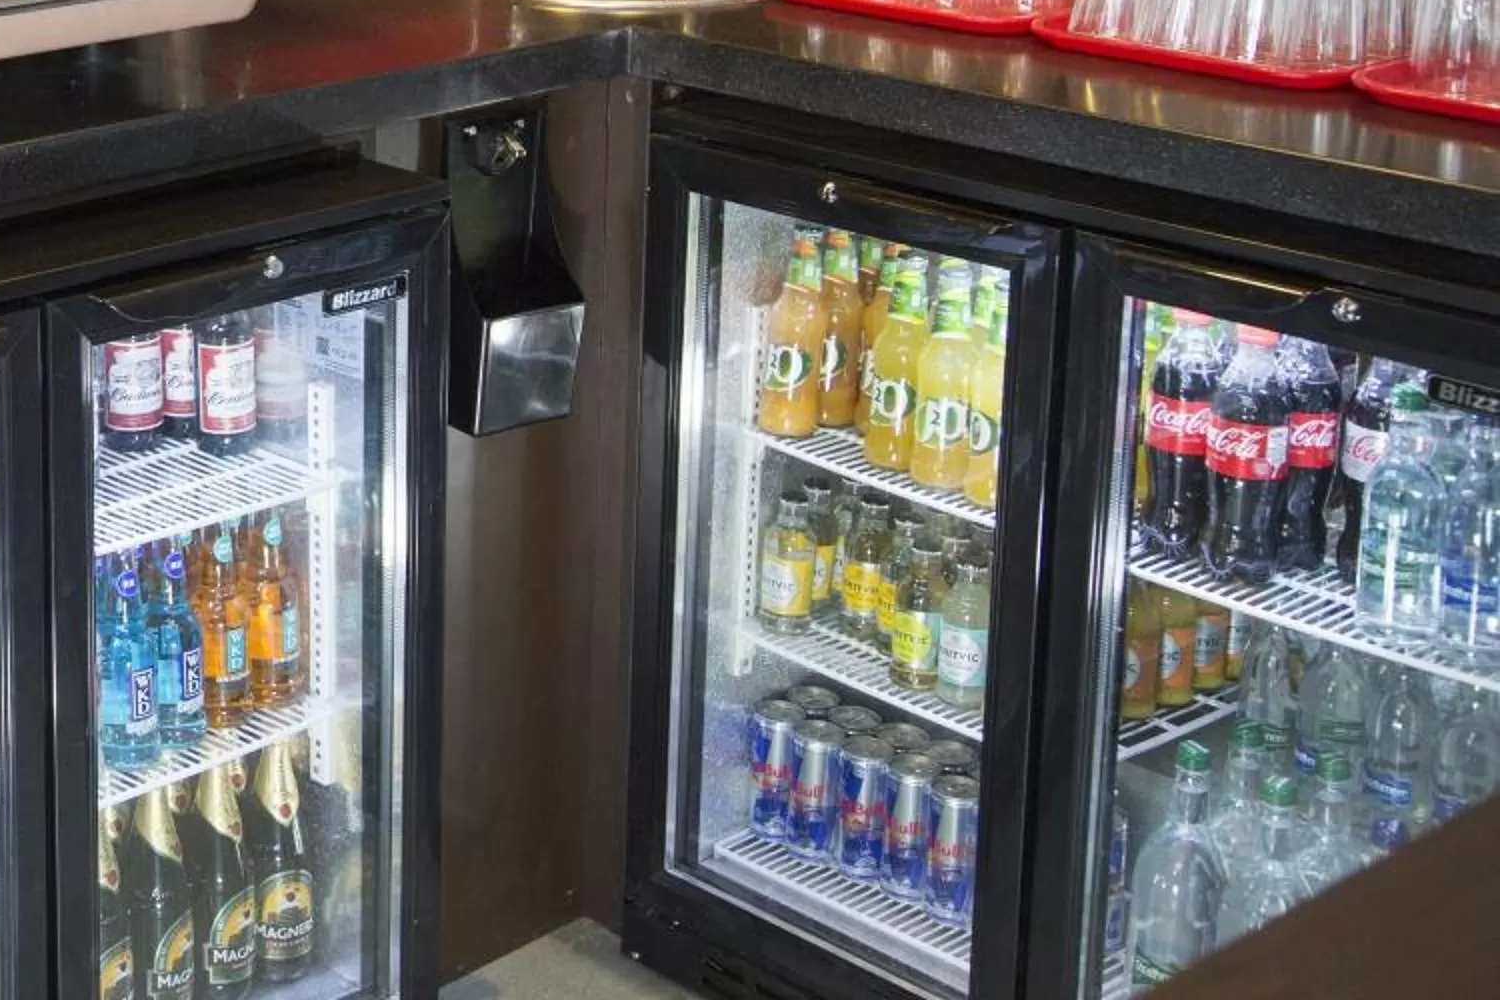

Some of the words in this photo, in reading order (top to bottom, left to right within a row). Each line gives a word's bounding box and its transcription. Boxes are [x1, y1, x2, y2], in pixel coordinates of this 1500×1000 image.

[332, 279, 397, 311] Blizzard
[135, 674, 152, 718] WKD
[187, 652, 200, 697] WKD
